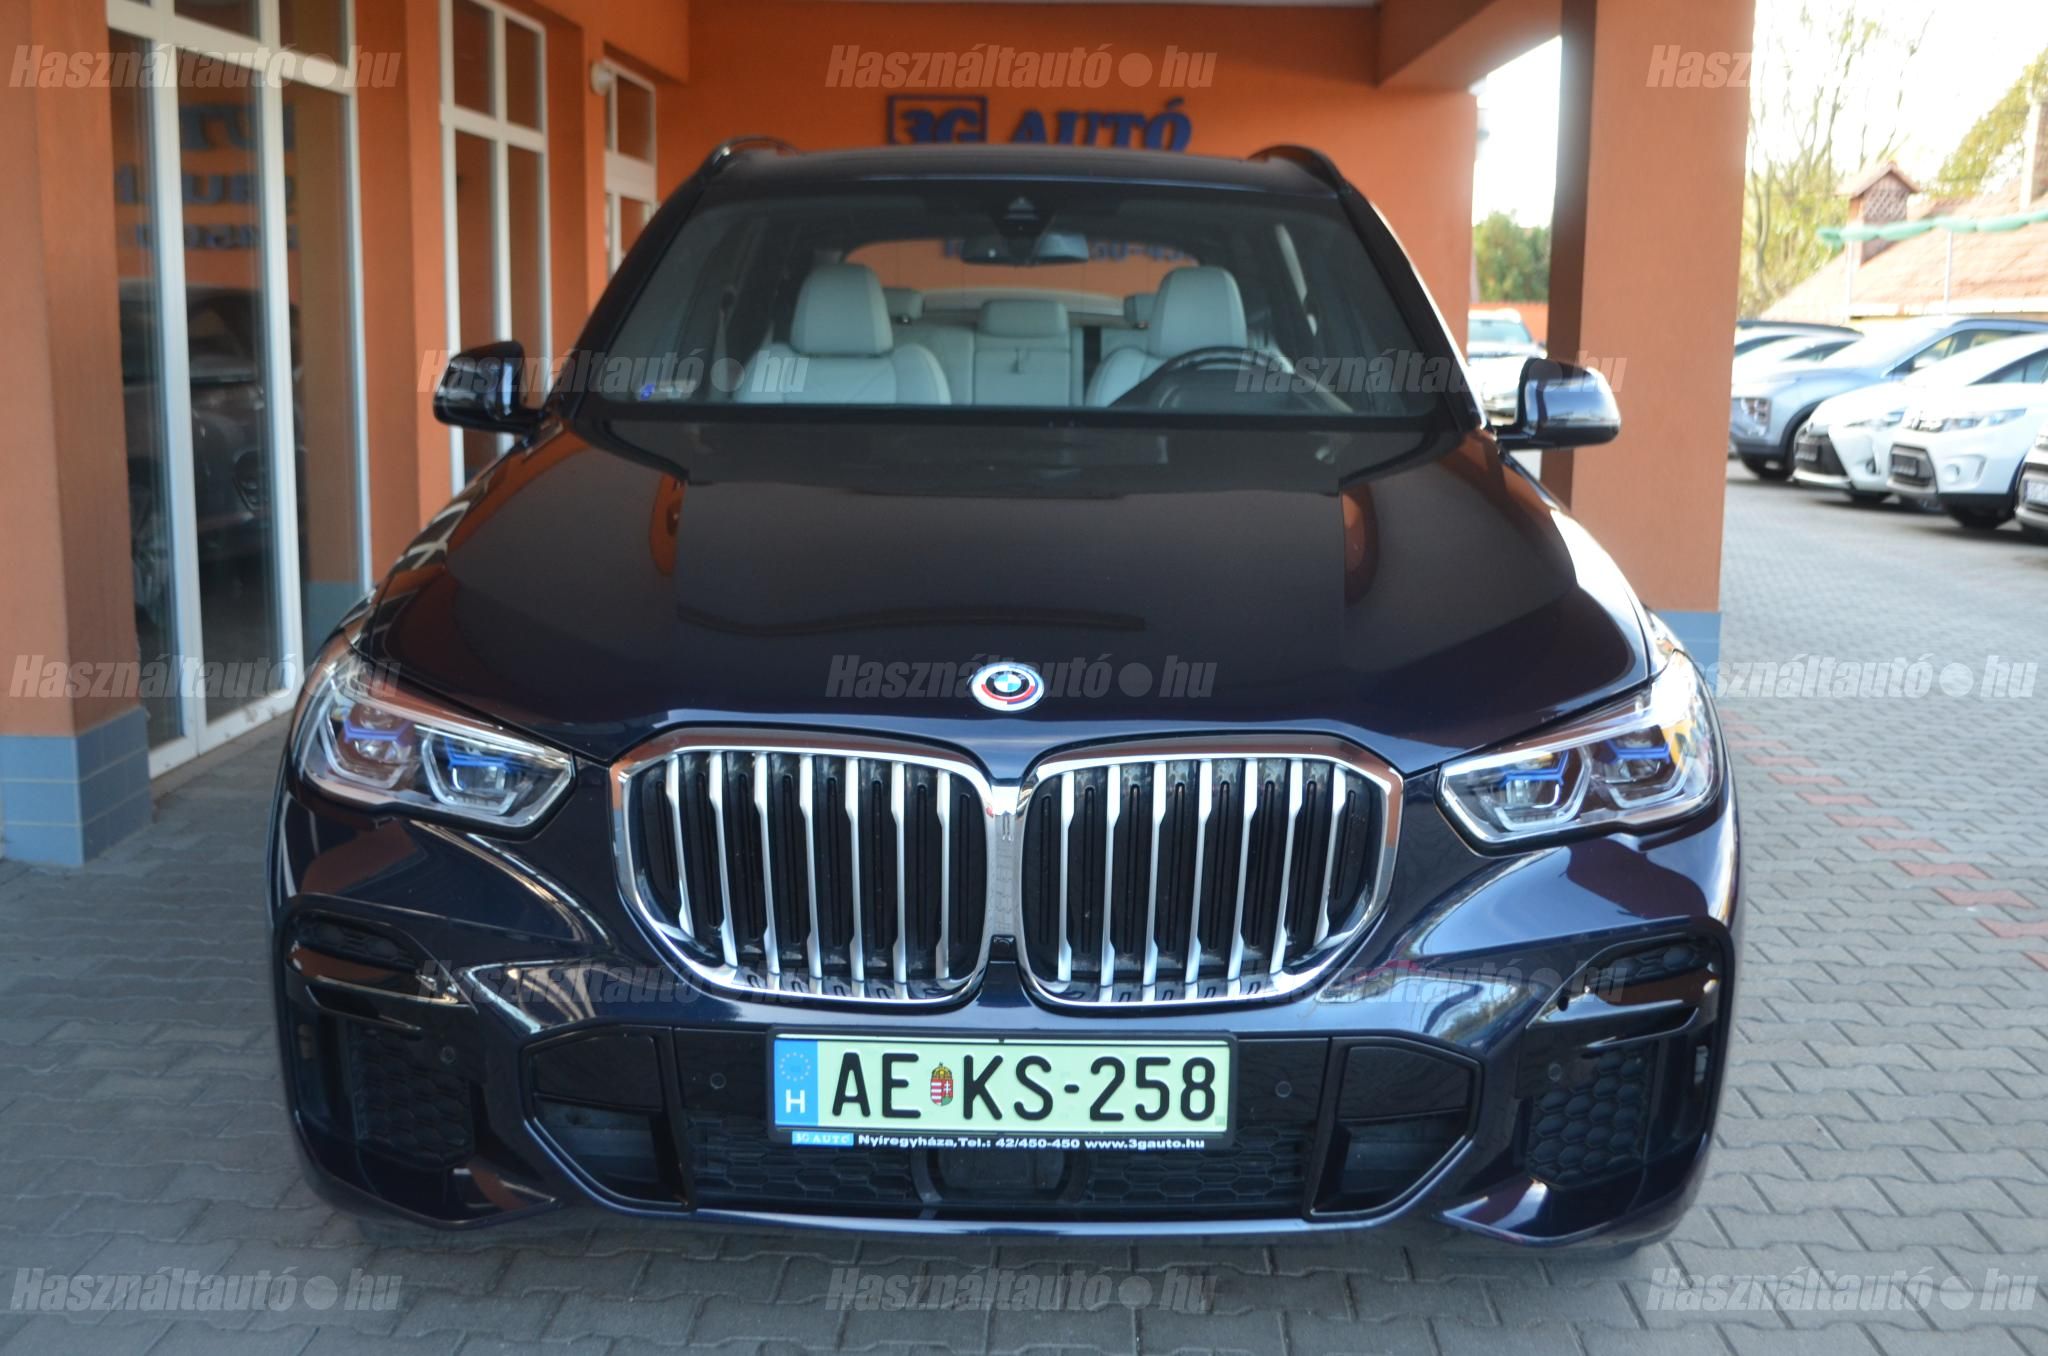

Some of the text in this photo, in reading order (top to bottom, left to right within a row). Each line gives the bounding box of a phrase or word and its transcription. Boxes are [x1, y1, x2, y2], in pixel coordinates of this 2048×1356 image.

[901, 97, 1193, 152] 3G AUTÓ
[785, 1089, 806, 1114] H
[832, 1052, 1216, 1121] AE KS-258
[995, 1137, 1080, 1149] 42/450-450
[1085, 1138, 1205, 1150] www.3gauto.hu
